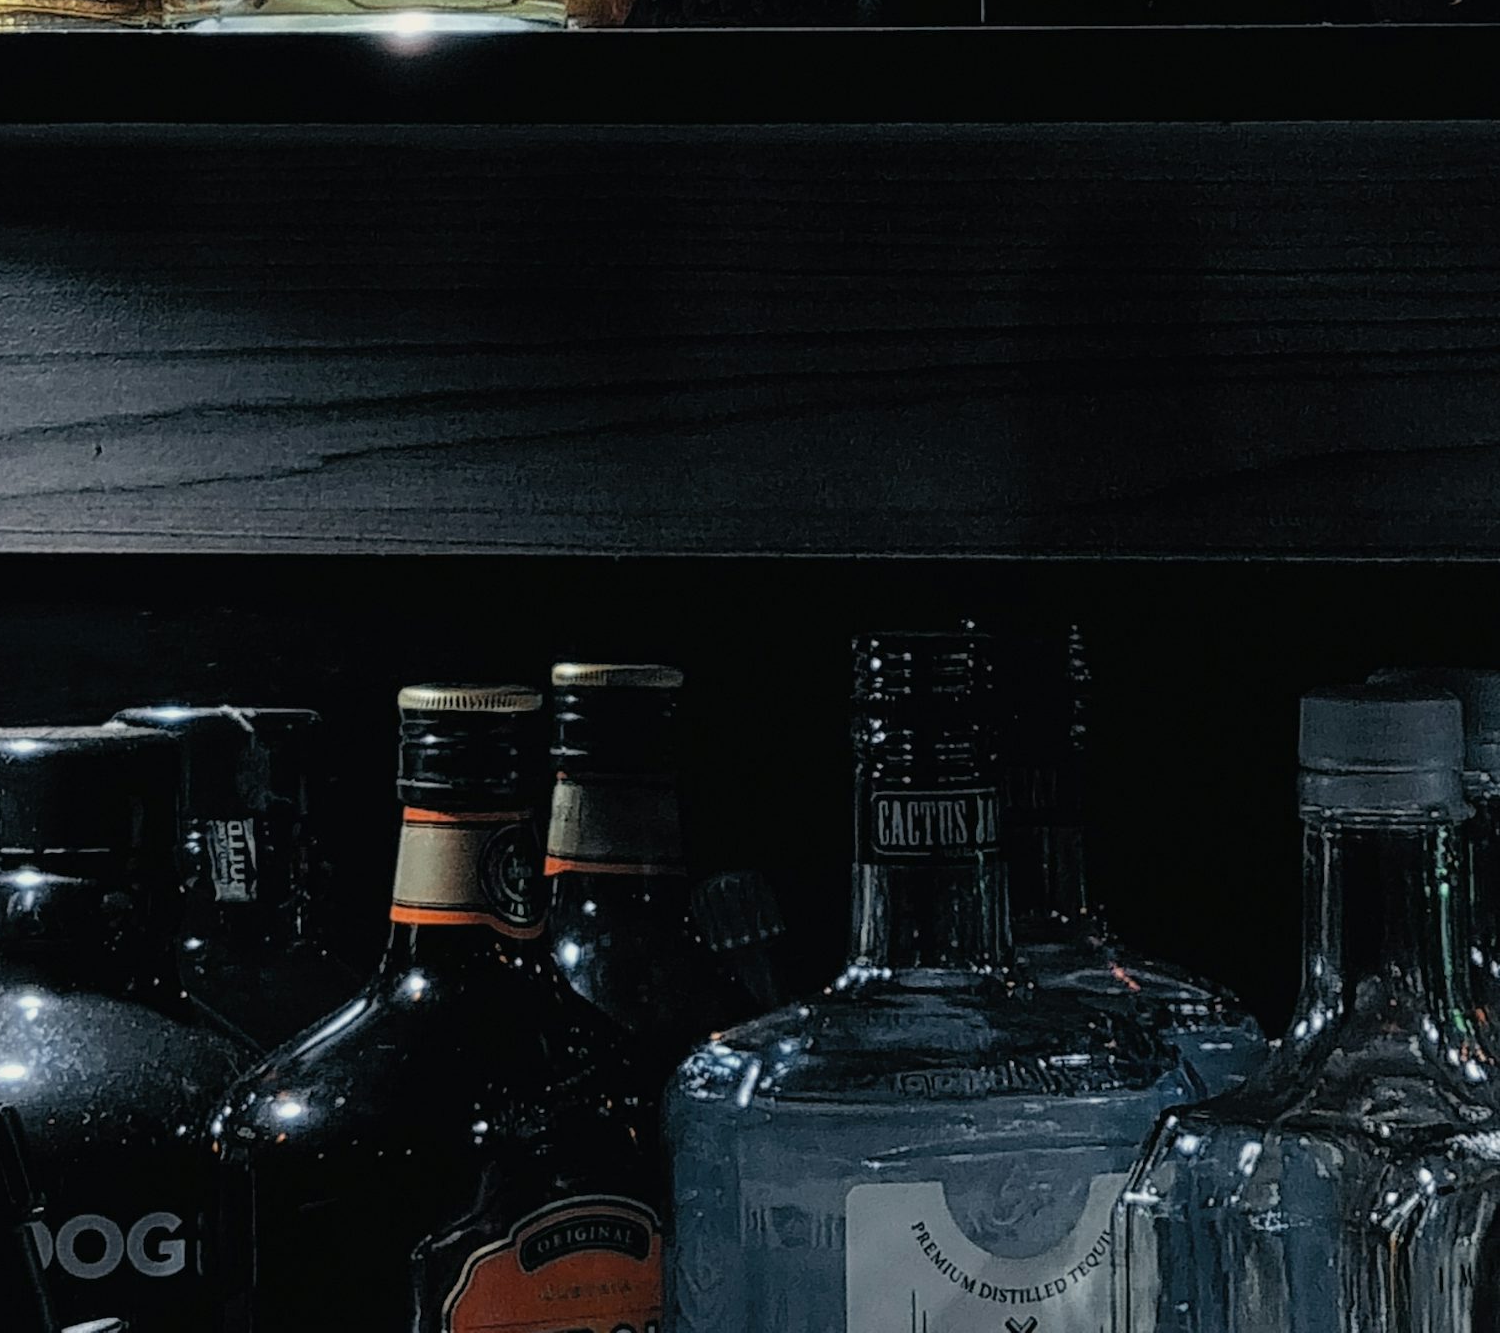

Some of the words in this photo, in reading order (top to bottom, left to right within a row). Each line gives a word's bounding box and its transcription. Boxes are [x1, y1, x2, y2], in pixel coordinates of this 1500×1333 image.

[877, 798, 969, 848] CACTUS
[537, 1225, 633, 1254] ORIGINAL
[911, 1220, 977, 1293] PREMIUM
[978, 1277, 1068, 1305] DISTILLED
